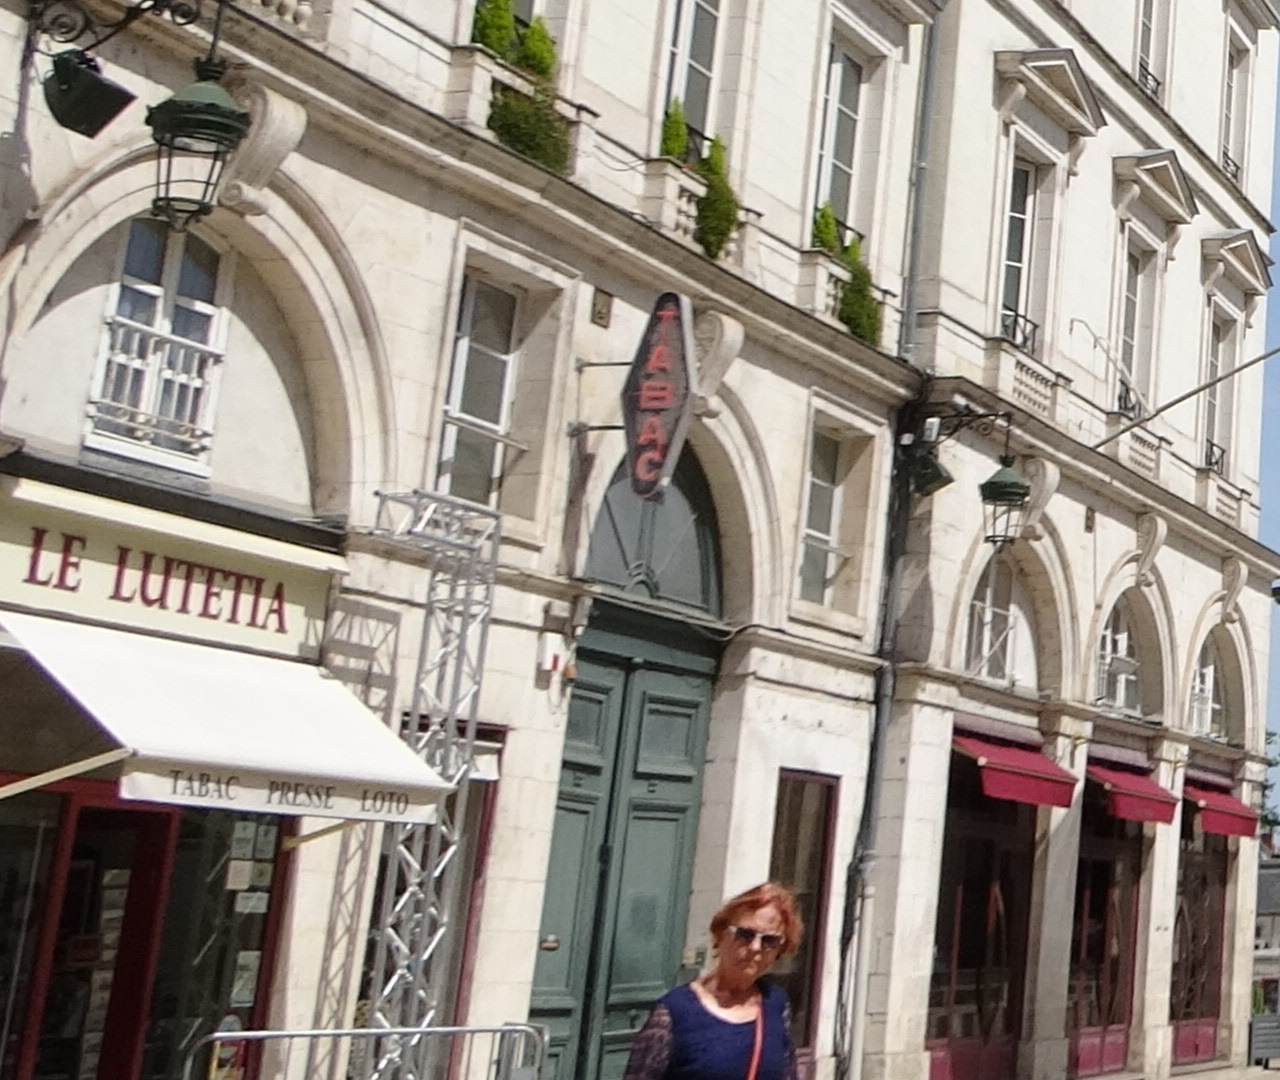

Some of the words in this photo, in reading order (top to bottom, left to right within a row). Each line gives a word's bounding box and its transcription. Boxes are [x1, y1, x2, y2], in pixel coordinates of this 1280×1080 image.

[637, 310, 678, 482] TABAC
[23, 526, 86, 593] LE
[109, 545, 288, 634] LUTETIA
[170, 770, 239, 801] TABAC
[266, 780, 337, 810] PRESSE
[359, 789, 410, 816] LOTO
